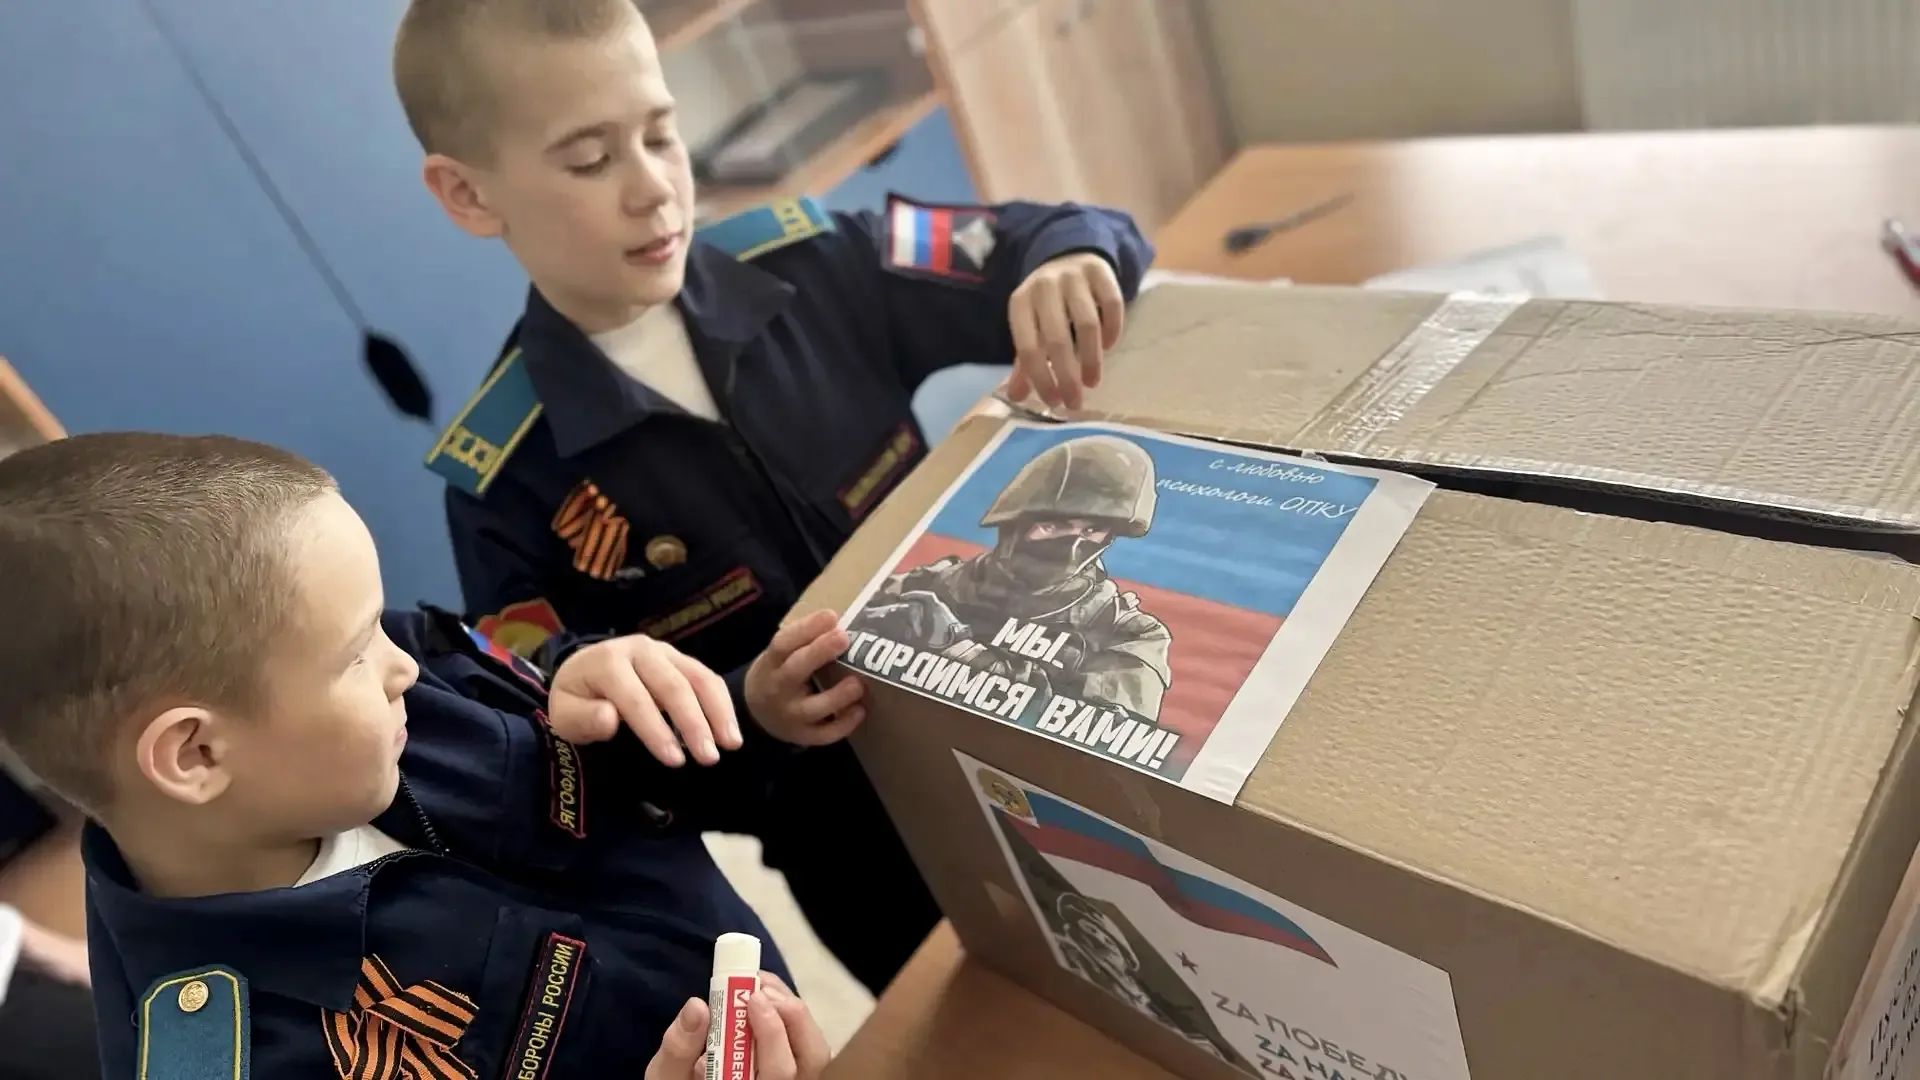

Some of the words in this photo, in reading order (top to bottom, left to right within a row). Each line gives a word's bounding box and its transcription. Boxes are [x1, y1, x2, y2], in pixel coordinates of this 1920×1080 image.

[1156, 478, 1274, 507] психологи
[1280, 497, 1359, 519] ОПКУ
[1227, 462, 1325, 484] любовью
[991, 617, 1071, 669] МЫ
[847, 631, 1037, 721] ГОРДИМСЯ
[1036, 695, 1181, 770] ВАМИ!
[542, 942, 574, 1009] РОССИИ
[732, 1009, 747, 1080] BRAUBER
[1264, 1013, 1408, 1080] ПОБЕД
